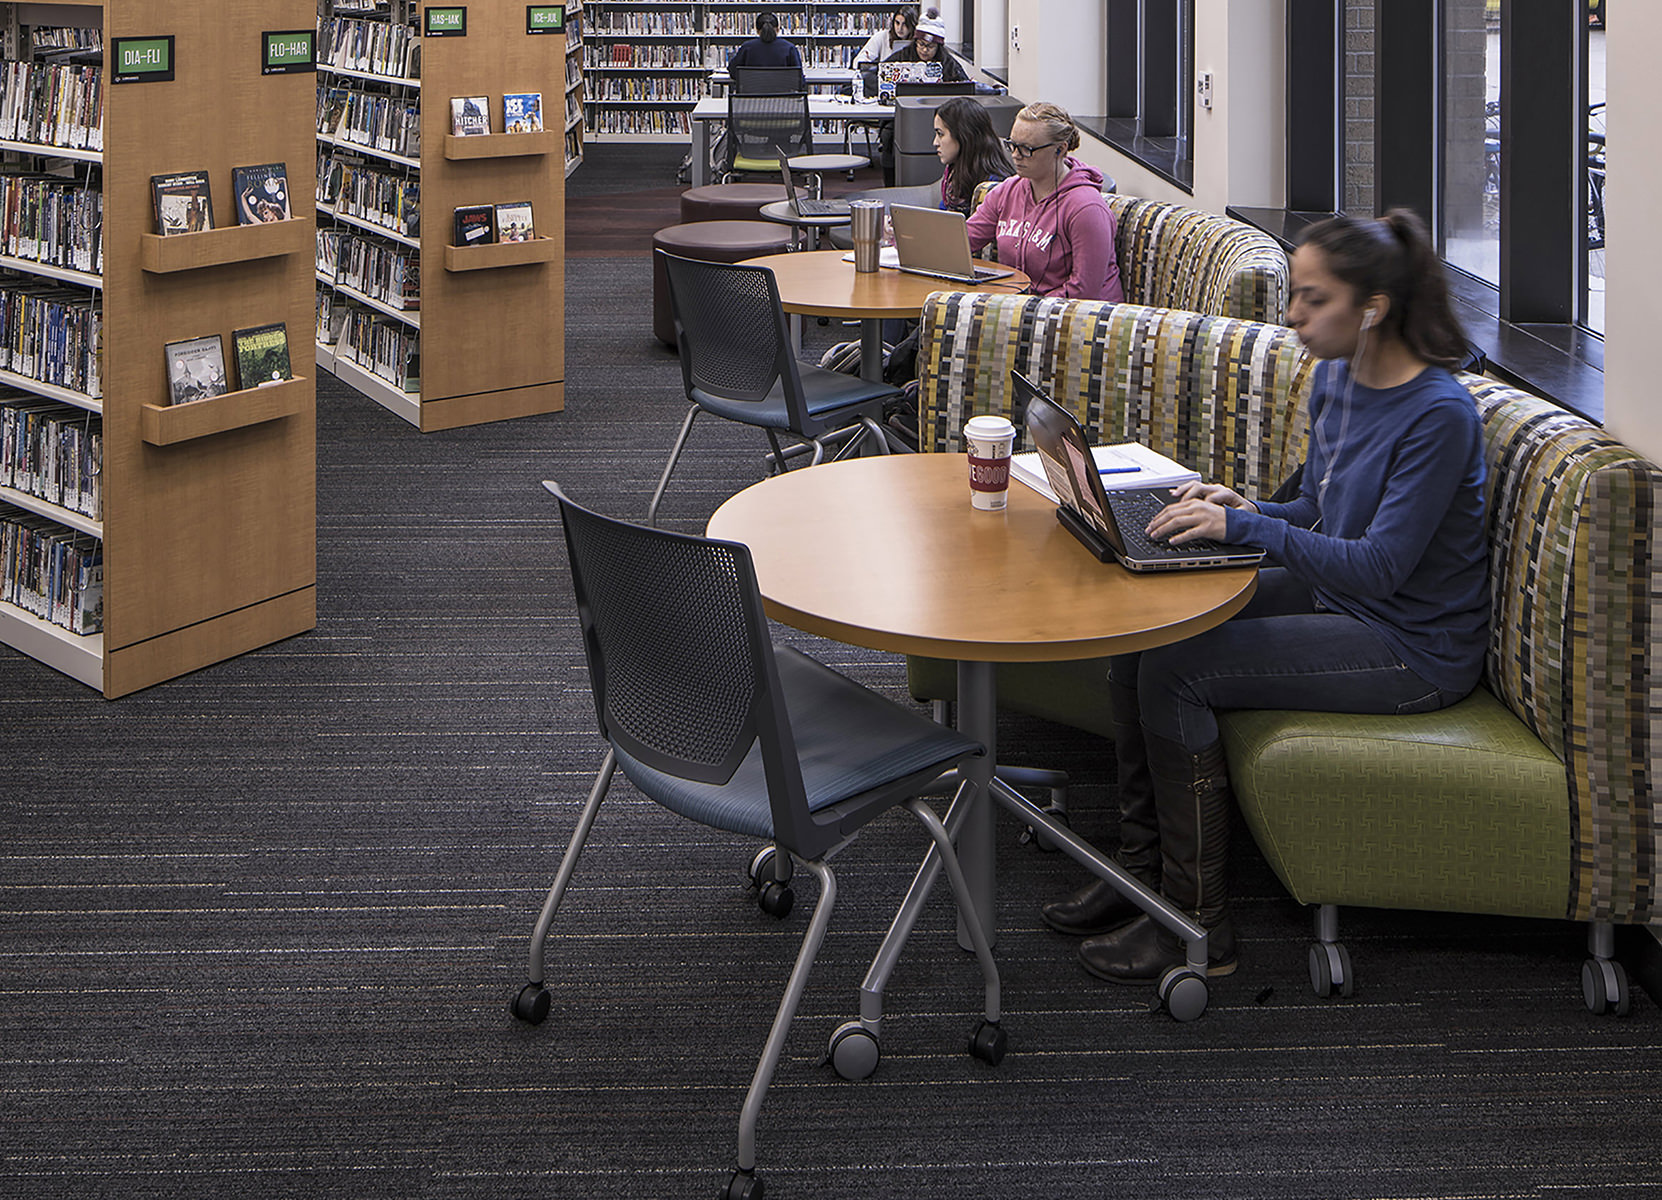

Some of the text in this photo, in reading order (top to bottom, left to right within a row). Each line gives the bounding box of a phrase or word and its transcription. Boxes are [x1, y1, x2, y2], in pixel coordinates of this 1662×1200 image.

[431, 14, 459, 25] HAS-IAK
[534, 12, 557, 23] ICE-JUL
[270, 41, 307, 58] FLO-HAR
[124, 48, 160, 66] DIA-FLI
